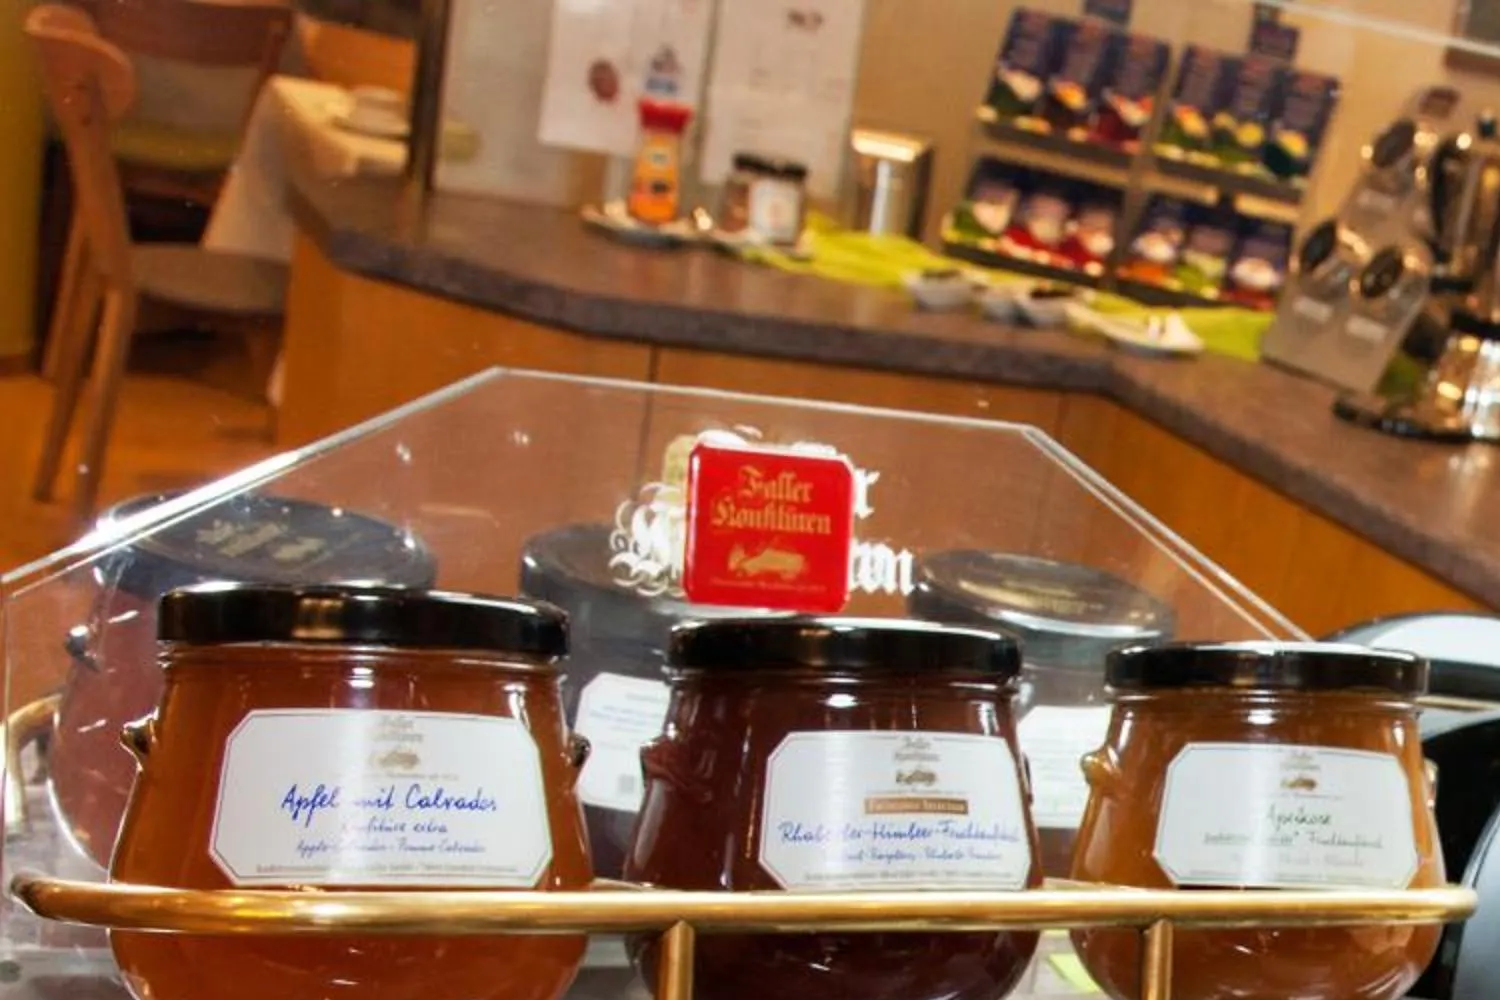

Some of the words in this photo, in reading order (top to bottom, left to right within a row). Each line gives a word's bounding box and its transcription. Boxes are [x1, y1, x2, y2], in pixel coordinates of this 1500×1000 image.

[737, 465, 814, 503] Faller
[711, 496, 831, 534] Konfitüren
[281, 783, 340, 828] Apfel
[405, 784, 497, 811] Calvados
